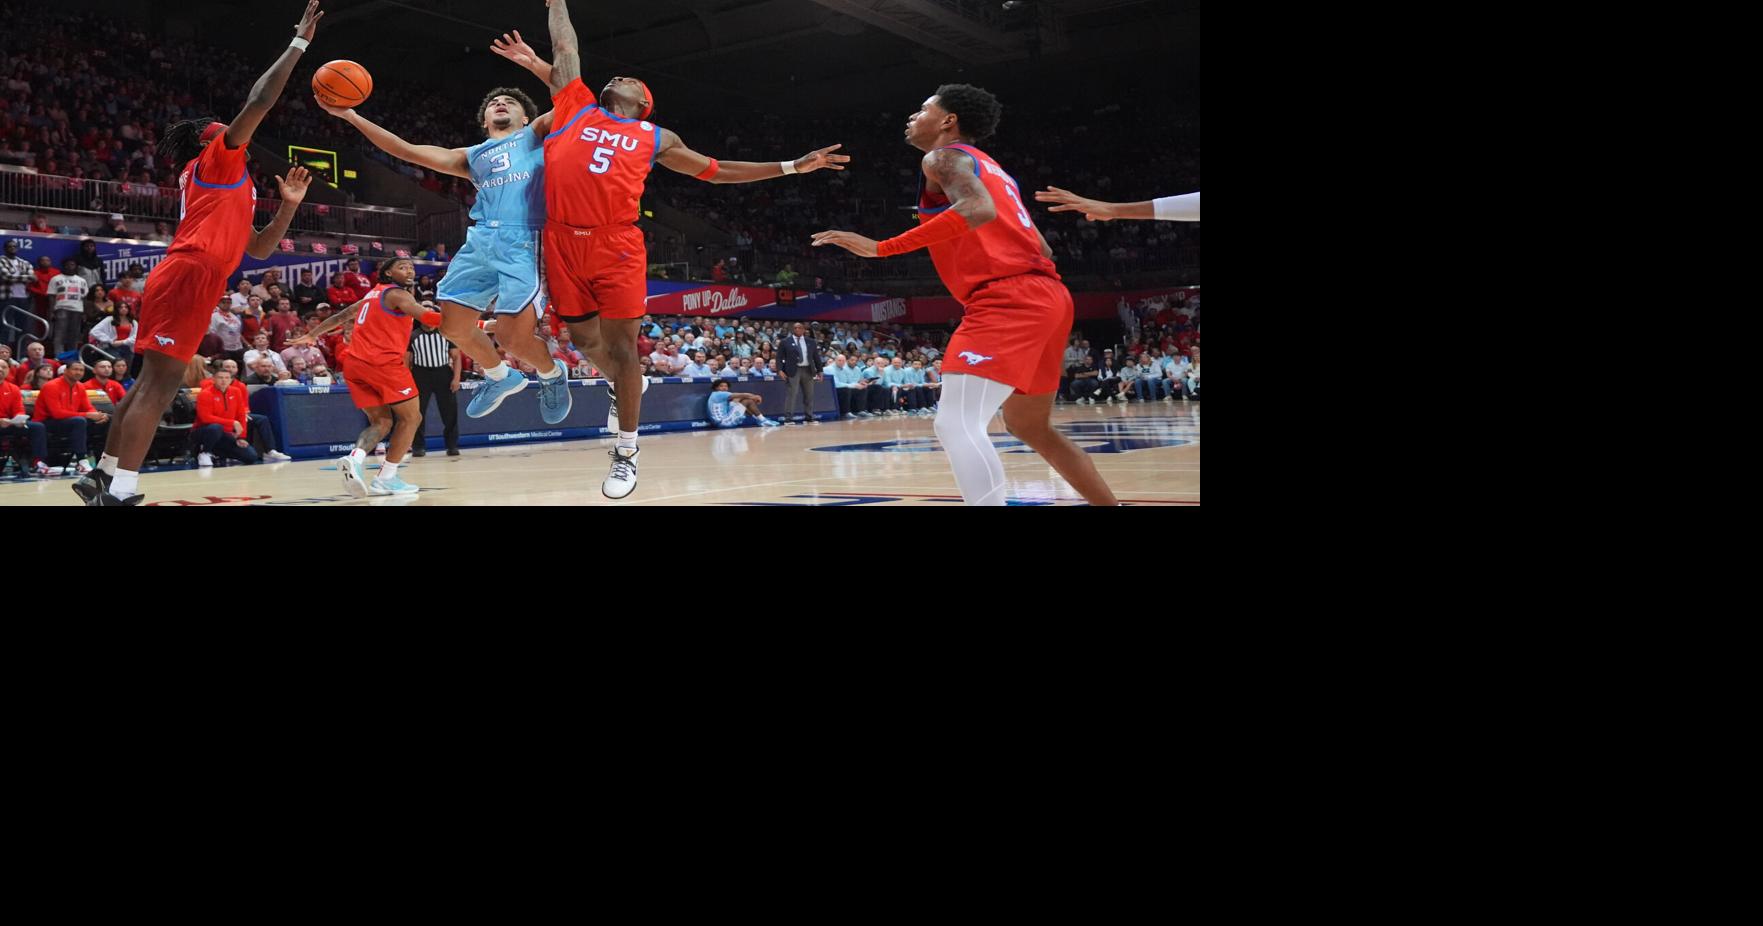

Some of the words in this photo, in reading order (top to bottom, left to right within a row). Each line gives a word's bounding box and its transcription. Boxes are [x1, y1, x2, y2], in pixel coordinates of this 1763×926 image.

[579, 127, 639, 151] SMU
[490, 152, 511, 173] 3
[588, 147, 615, 175] 5
[477, 171, 531, 189] AROINA
[1005, 184, 1031, 228] 3
[118, 248, 131, 257] THE
[682, 292, 701, 312] PONY
[702, 289, 712, 307] UP
[710, 287, 748, 313] Dallas
[357, 302, 370, 325] 0
[308, 386, 330, 394] UTSW
[488, 432, 530, 441] UTSouthwestern
